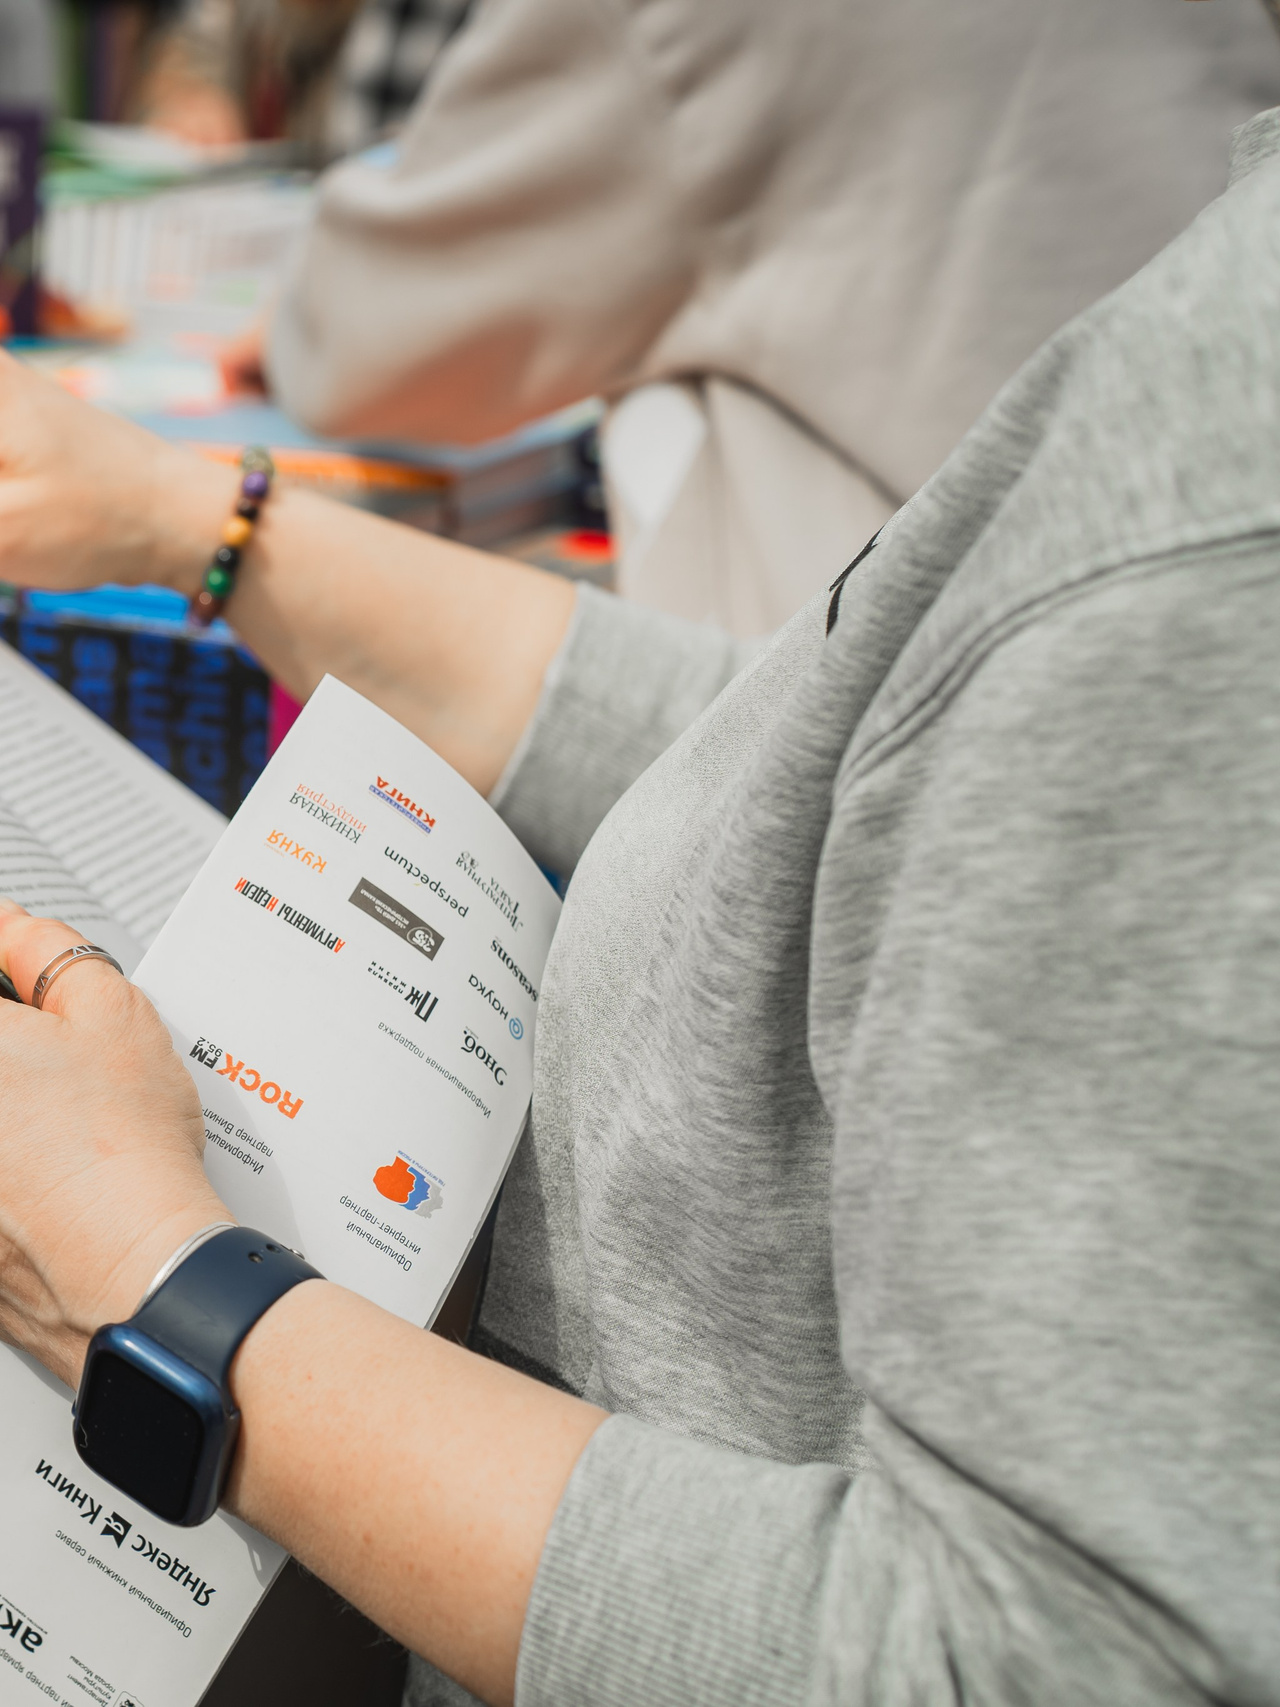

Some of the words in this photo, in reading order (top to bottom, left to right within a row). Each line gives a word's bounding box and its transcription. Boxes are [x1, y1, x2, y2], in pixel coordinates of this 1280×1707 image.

[289, 792, 361, 844] КНИЖНАЯ
[377, 776, 435, 828] КНИГА
[266, 830, 327, 874] КУХНЯ
[234, 877, 279, 912] НЕДЕЛИ
[384, 846, 469, 918] perspectum
[277, 903, 346, 953] АРГУМЕНТЫ
[490, 940, 539, 1002] seasons
[189, 1044, 218, 1069] FM
[196, 1036, 223, 1057] 95.2
[378, 1022, 424, 1058] поддержка
[215, 1053, 304, 1120] ROCK
[426, 1056, 491, 1119] Информационная
[205, 1130, 264, 1175] Информацио
[236, 1129, 274, 1157] партнер
[340, 1196, 421, 1255] интернет-партнер
[346, 1222, 412, 1272] Официальный
[35, 1458, 103, 1525] Книги
[55, 1530, 86, 1557] сервис
[87, 1554, 128, 1588] книжный
[131, 1534, 216, 1607] Яндекс
[128, 1585, 192, 1638] Официальный
[26, 1670, 61, 1703] партнер
